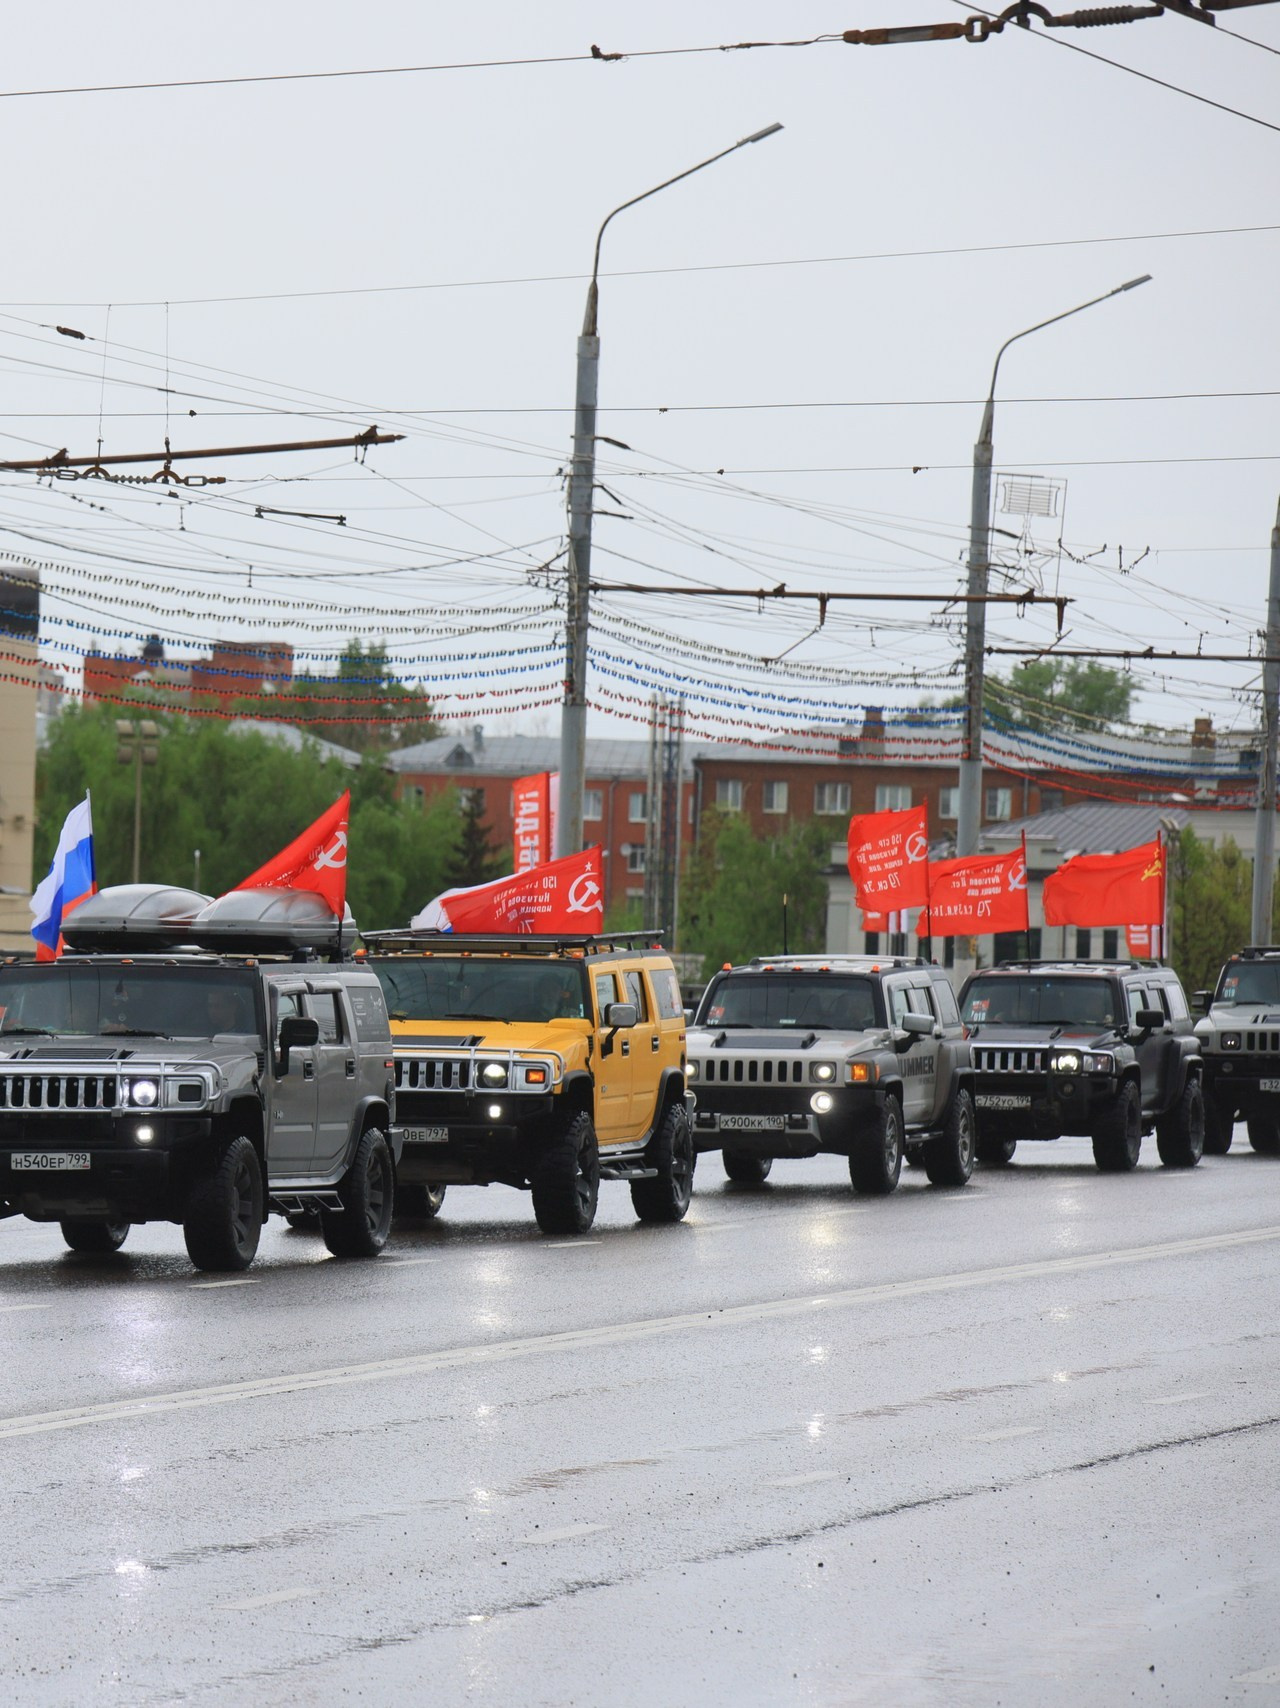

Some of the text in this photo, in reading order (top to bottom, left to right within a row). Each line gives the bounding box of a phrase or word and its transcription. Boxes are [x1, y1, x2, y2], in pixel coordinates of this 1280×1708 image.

[723, 1116, 782, 1128] Х900КК 190
[427, 1128, 445, 1138] 797
[15, 1153, 88, 1169] Н540ЕР 799
